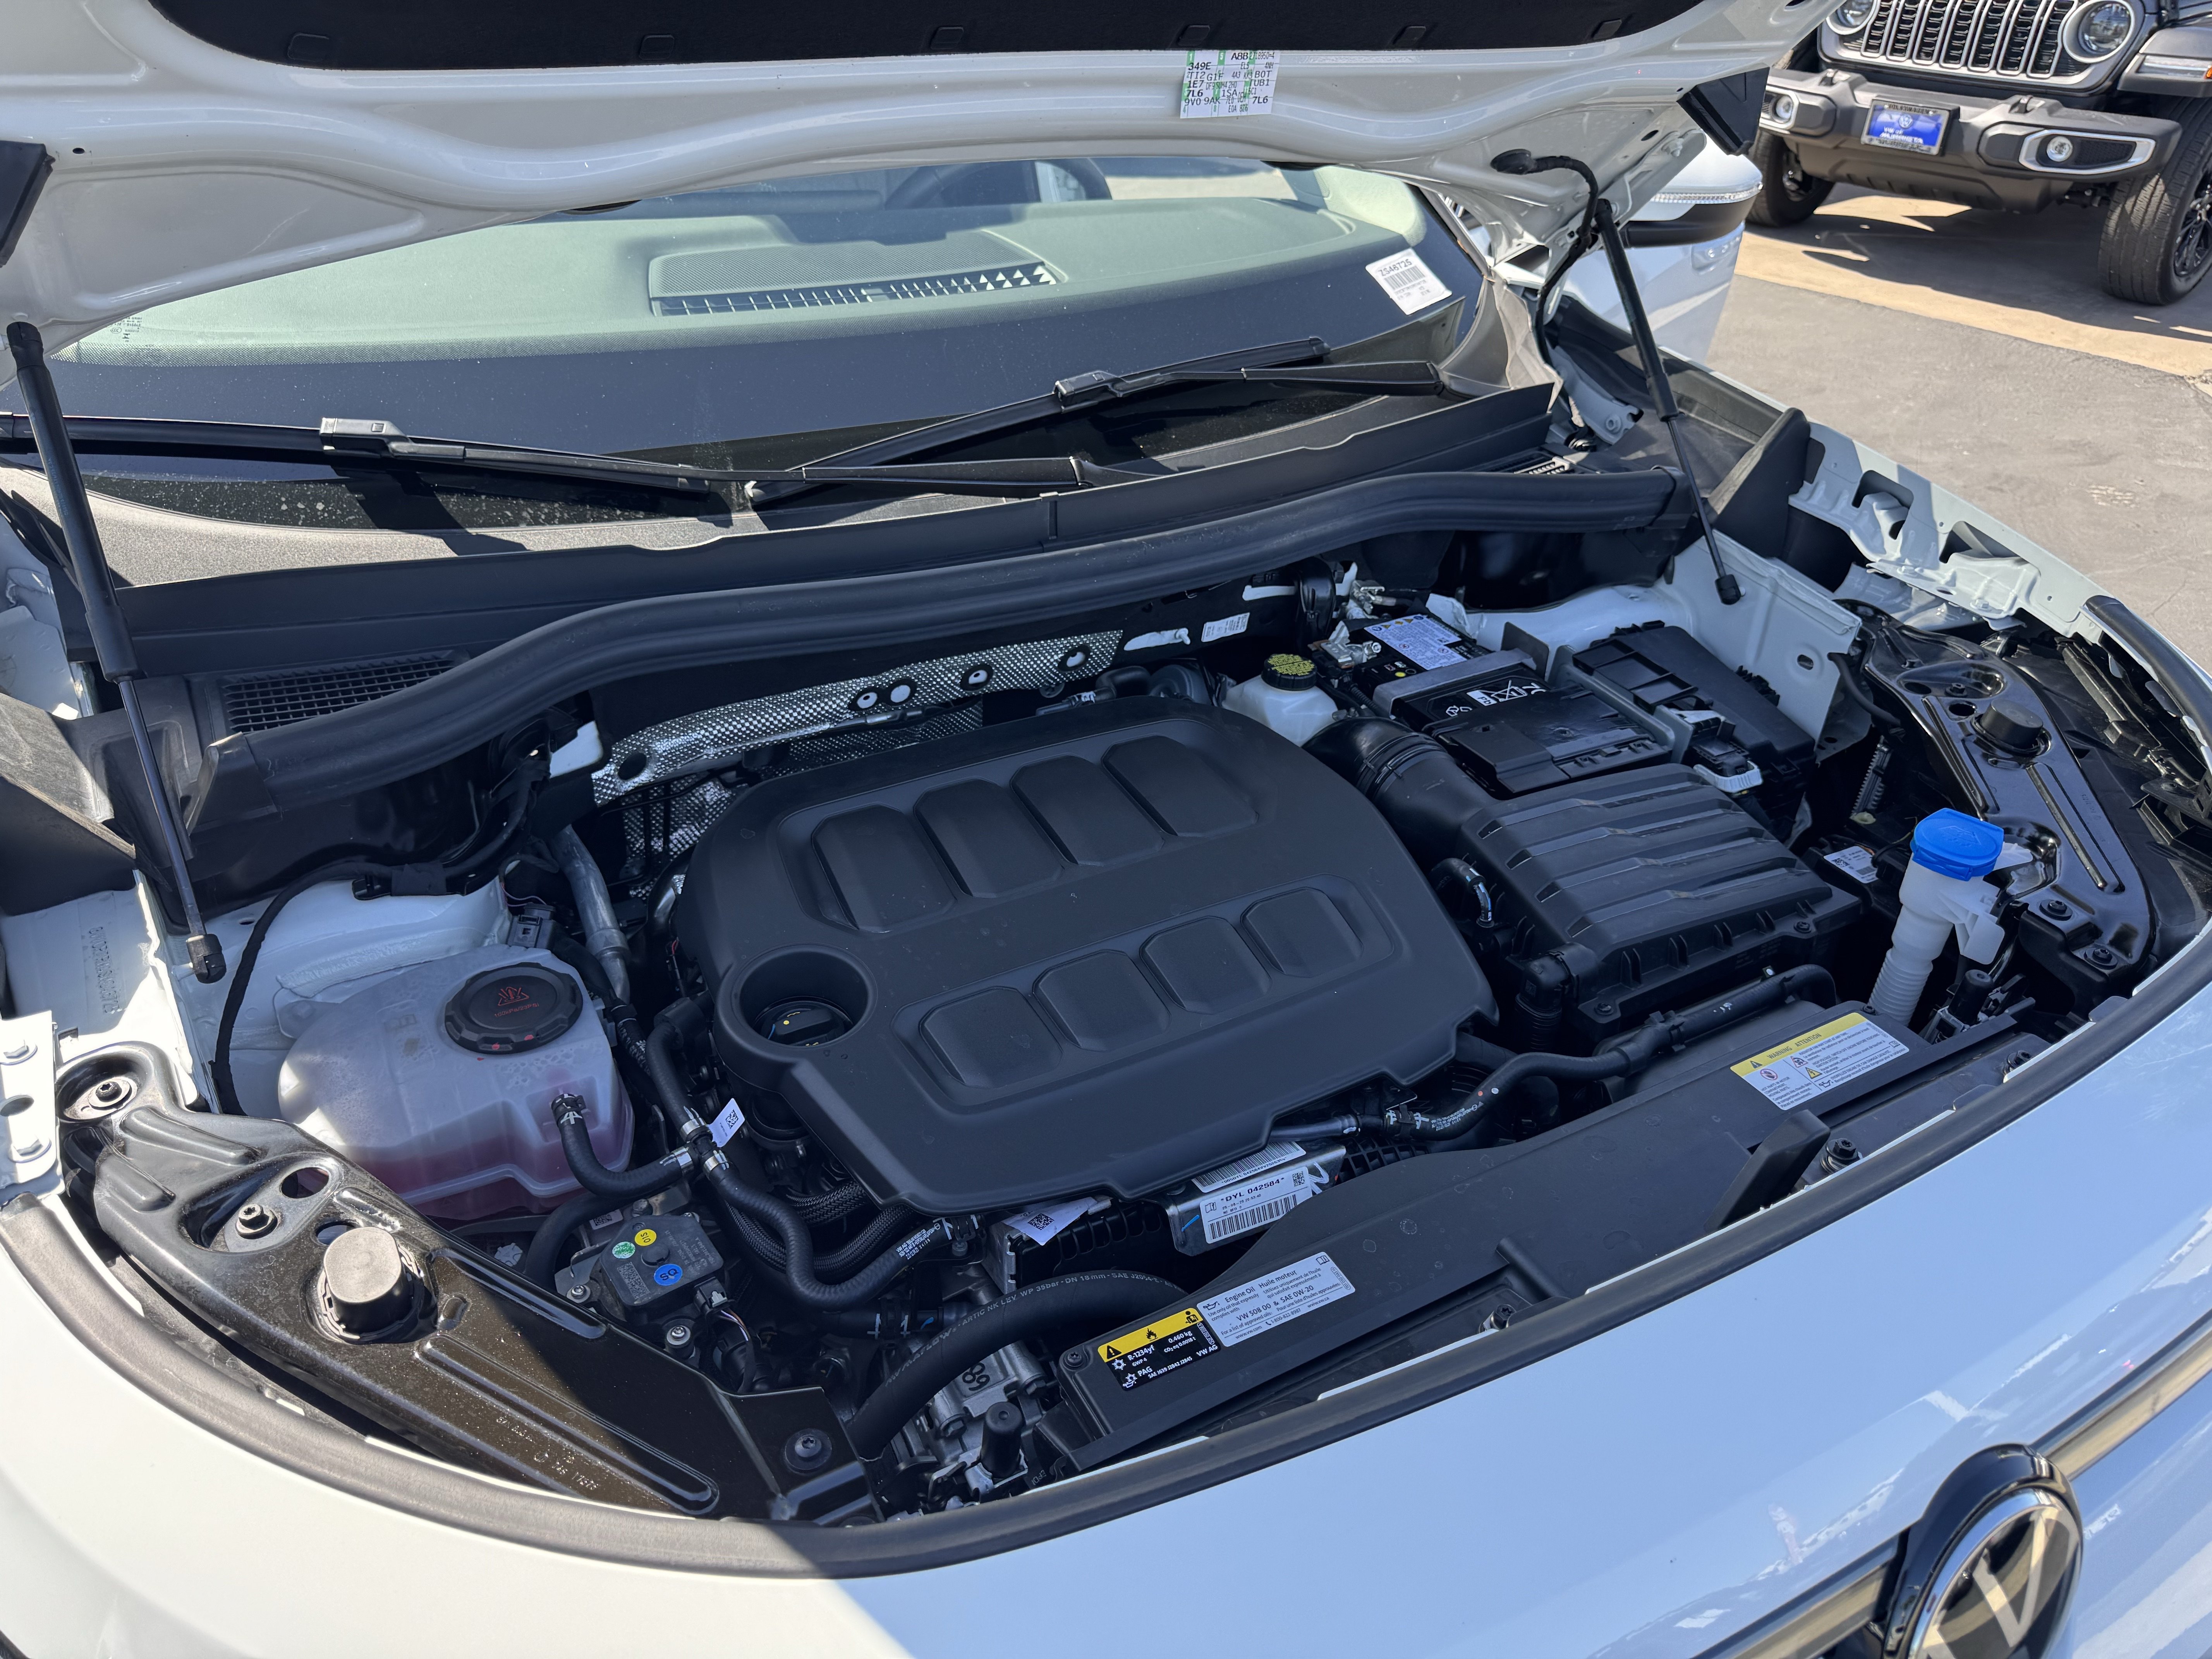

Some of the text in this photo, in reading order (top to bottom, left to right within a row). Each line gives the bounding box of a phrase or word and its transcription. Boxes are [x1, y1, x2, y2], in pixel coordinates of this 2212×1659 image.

[1478, 697, 1491, 705] Pb
[1767, 1033, 1822, 1059] WARNING ATTENTION
[660, 1268, 679, 1281] SQ
[1224, 1269, 1297, 1304] Engine Oil Huile moteur
[1263, 1285, 1279, 1294] Utilisez
[1278, 1274, 1304, 1288] uniquement
[1273, 1286, 1291, 1295] satisfait
[1289, 1274, 1318, 1289] expressément
[1302, 1291, 1318, 1300] d'huiles
[1317, 1281, 1341, 1295] approuvées:
[963, 1309, 985, 1325] ARTIC
[987, 1302, 999, 1311] NK
[1001, 1294, 1017, 1305] LEV
[1020, 1288, 1034, 1297] WP
[1036, 1281, 1059, 1291] 35bar
[1214, 1307, 1226, 1315] only
[1239, 1292, 1260, 1304] expressly
[1236, 1312, 1250, 1321] VW
[1249, 1307, 1262, 1316] 508
[1280, 1293, 1293, 1303] SAE
[1292, 1285, 1314, 1297] 0W-20
[1307, 1296, 1329, 1308] www.vw.ca
[1211, 1311, 1230, 1322] complies
[1243, 1314, 1264, 1326] approved
[1270, 1308, 1302, 1324] 1-800-822-8987
[1235, 1325, 1262, 1340] www.vw.com
[1127, 1345, 1156, 1362] R-1234yf
[1168, 1333, 1185, 1343] 0.460
[1196, 1348, 1208, 1357] VW
[1137, 1366, 1153, 1376] PAG
[1166, 1361, 1181, 1370] J2842
[1179, 1356, 1193, 1364] J2845
